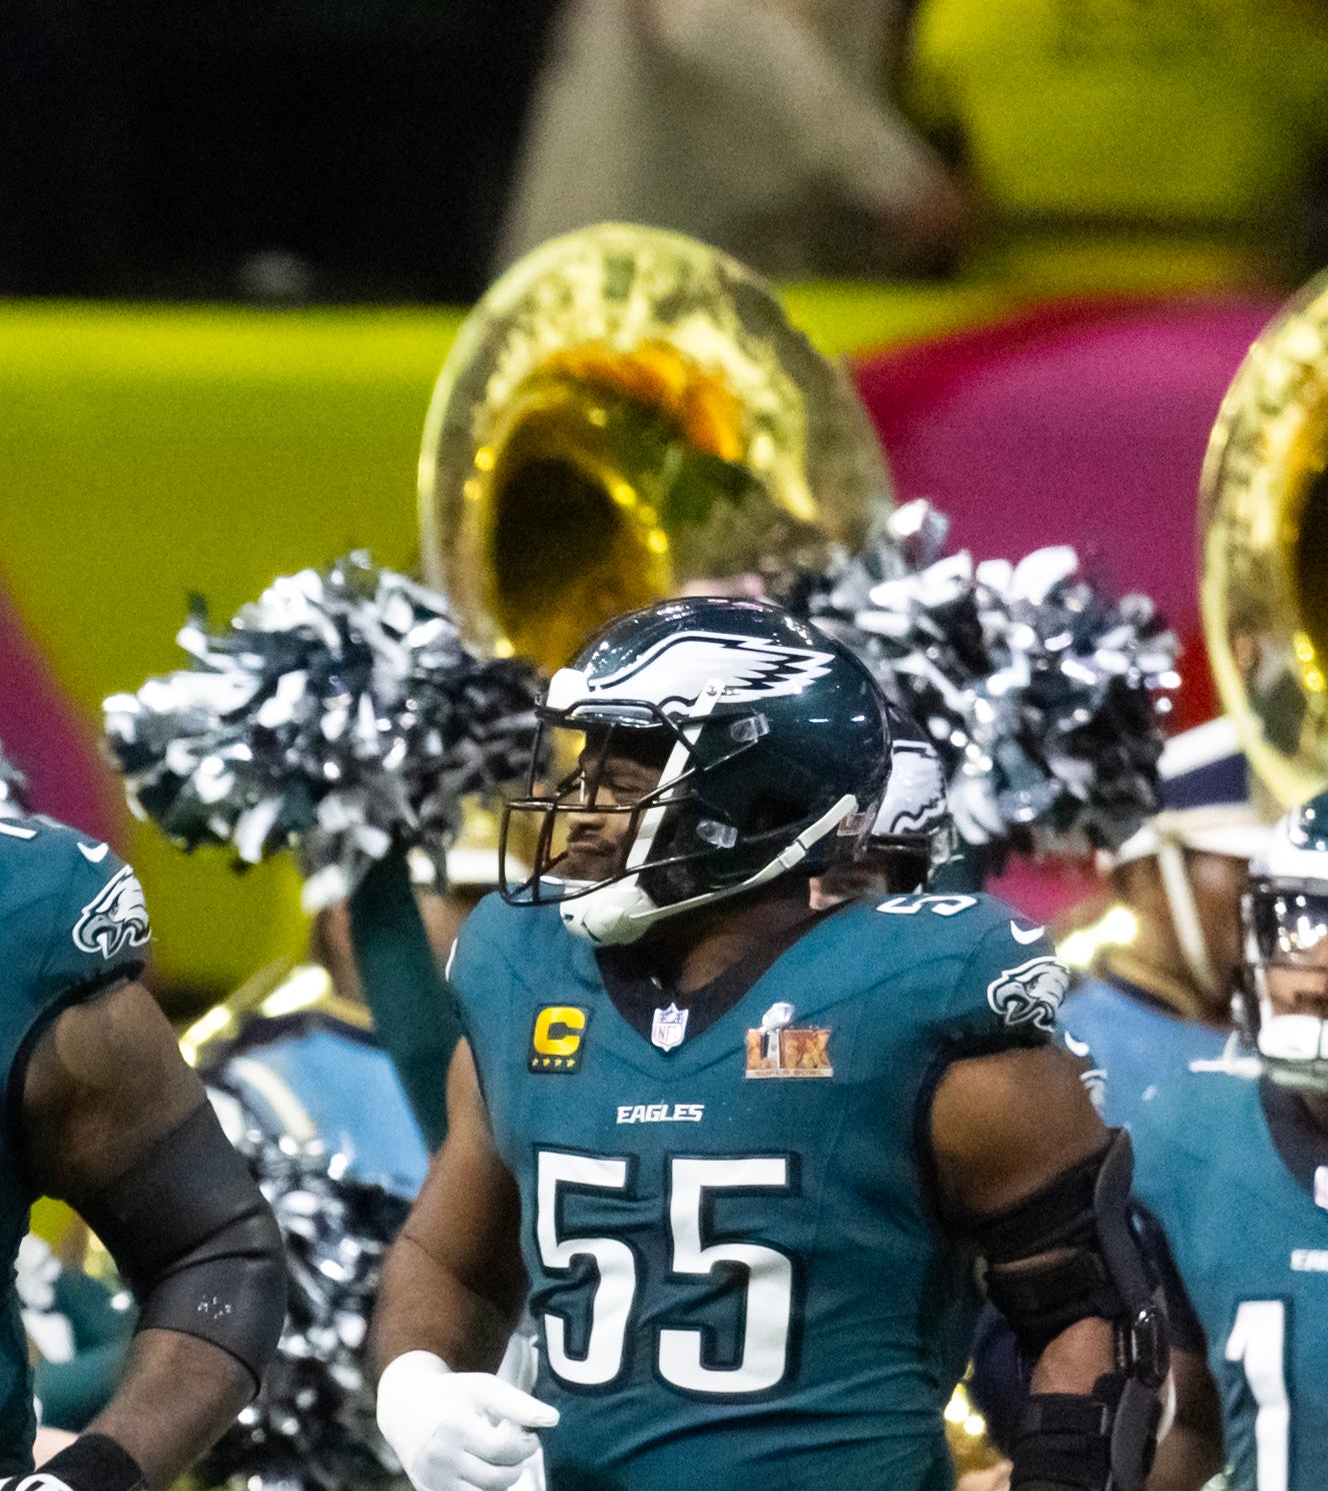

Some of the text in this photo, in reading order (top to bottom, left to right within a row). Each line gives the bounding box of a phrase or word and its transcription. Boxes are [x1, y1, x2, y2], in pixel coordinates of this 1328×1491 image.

[533, 1006, 586, 1057] C
[616, 1103, 705, 1124] EAGLES
[537, 1150, 793, 1394] 55
